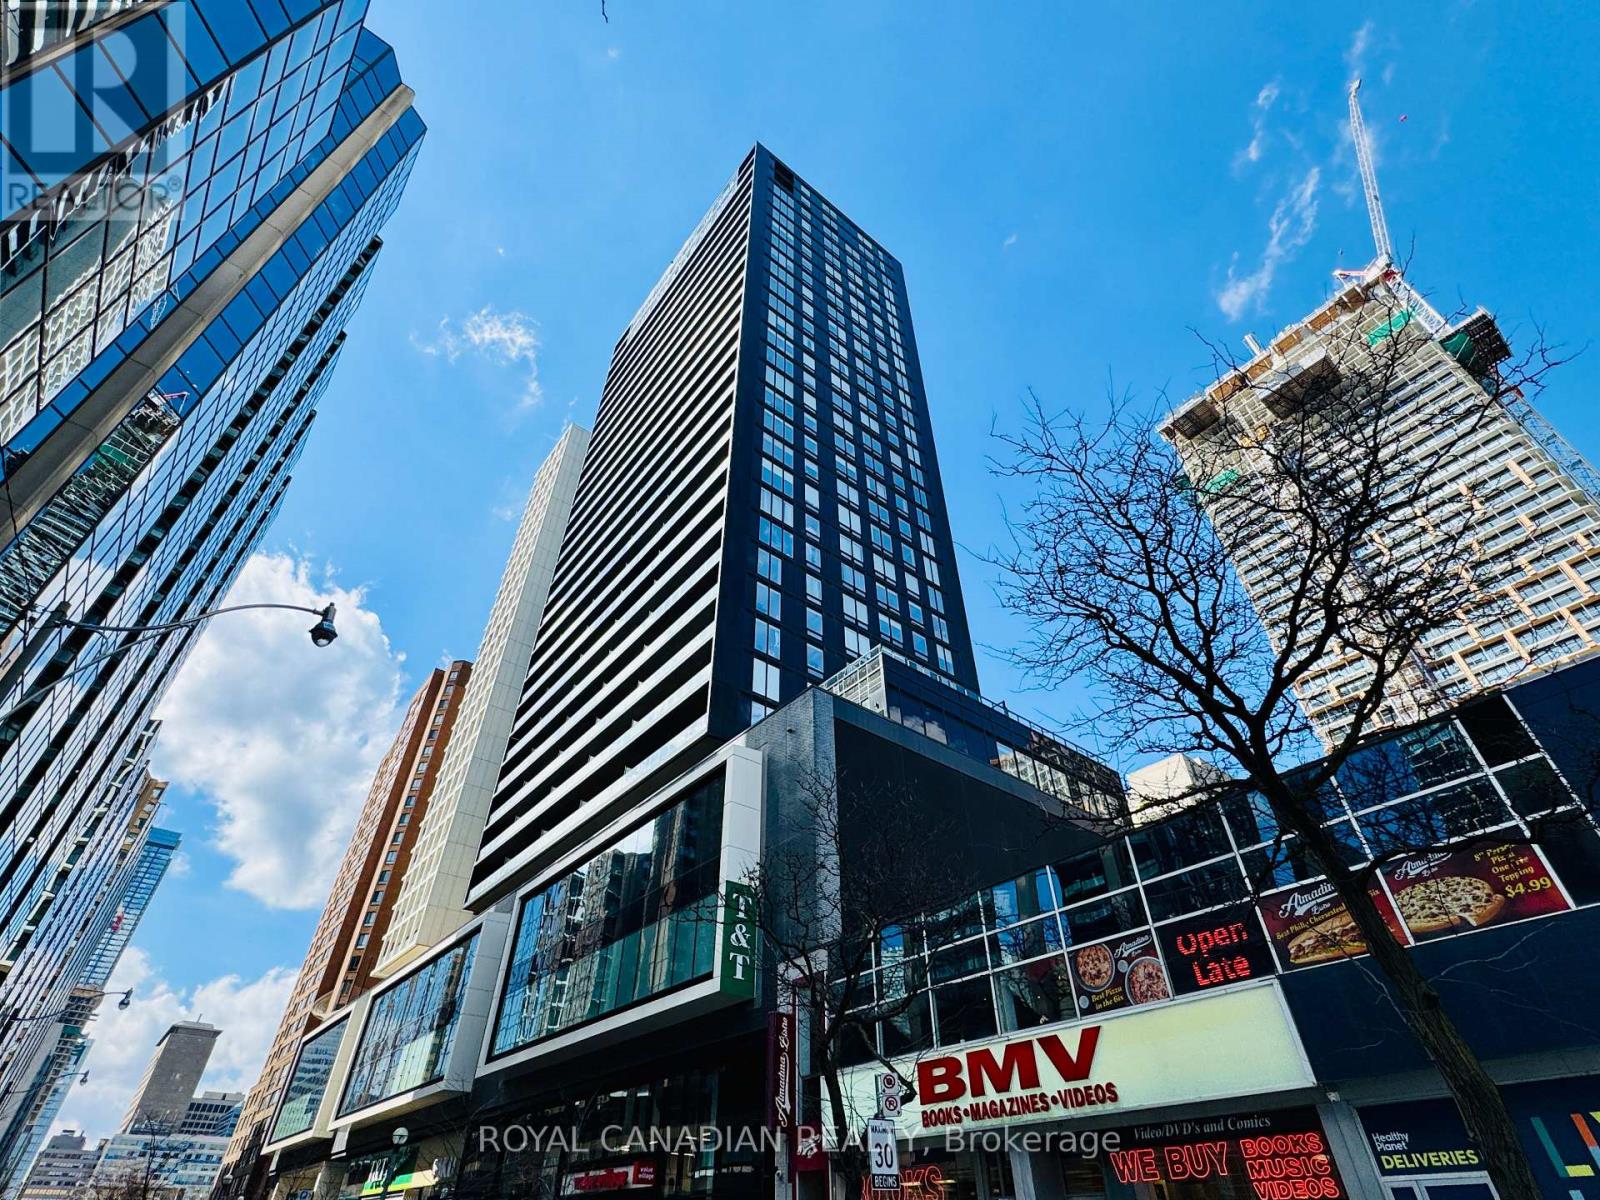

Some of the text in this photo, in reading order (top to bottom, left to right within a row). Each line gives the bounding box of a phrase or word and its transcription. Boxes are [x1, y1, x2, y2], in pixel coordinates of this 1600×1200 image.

[1505, 876, 1552, 899] $4.99
[729, 893, 752, 981] T&T
[1192, 955, 1251, 986] Late
[917, 1026, 1101, 1105] BMV
[1134, 1114, 1271, 1140] Video/DVD's and Comics
[1371, 1131, 1409, 1144] Healthy
[875, 1143, 894, 1168] 30
[1240, 1133, 1324, 1158] BOOKS
[1376, 1140, 1408, 1152] Planet
[1110, 1142, 1228, 1183] WE BUY
[1246, 1154, 1331, 1180] MUSIC
[1381, 1150, 1479, 1170] DELIVERIES
[874, 1175, 897, 1188] BEGINS
[1253, 1177, 1340, 1200] VIDEOS
